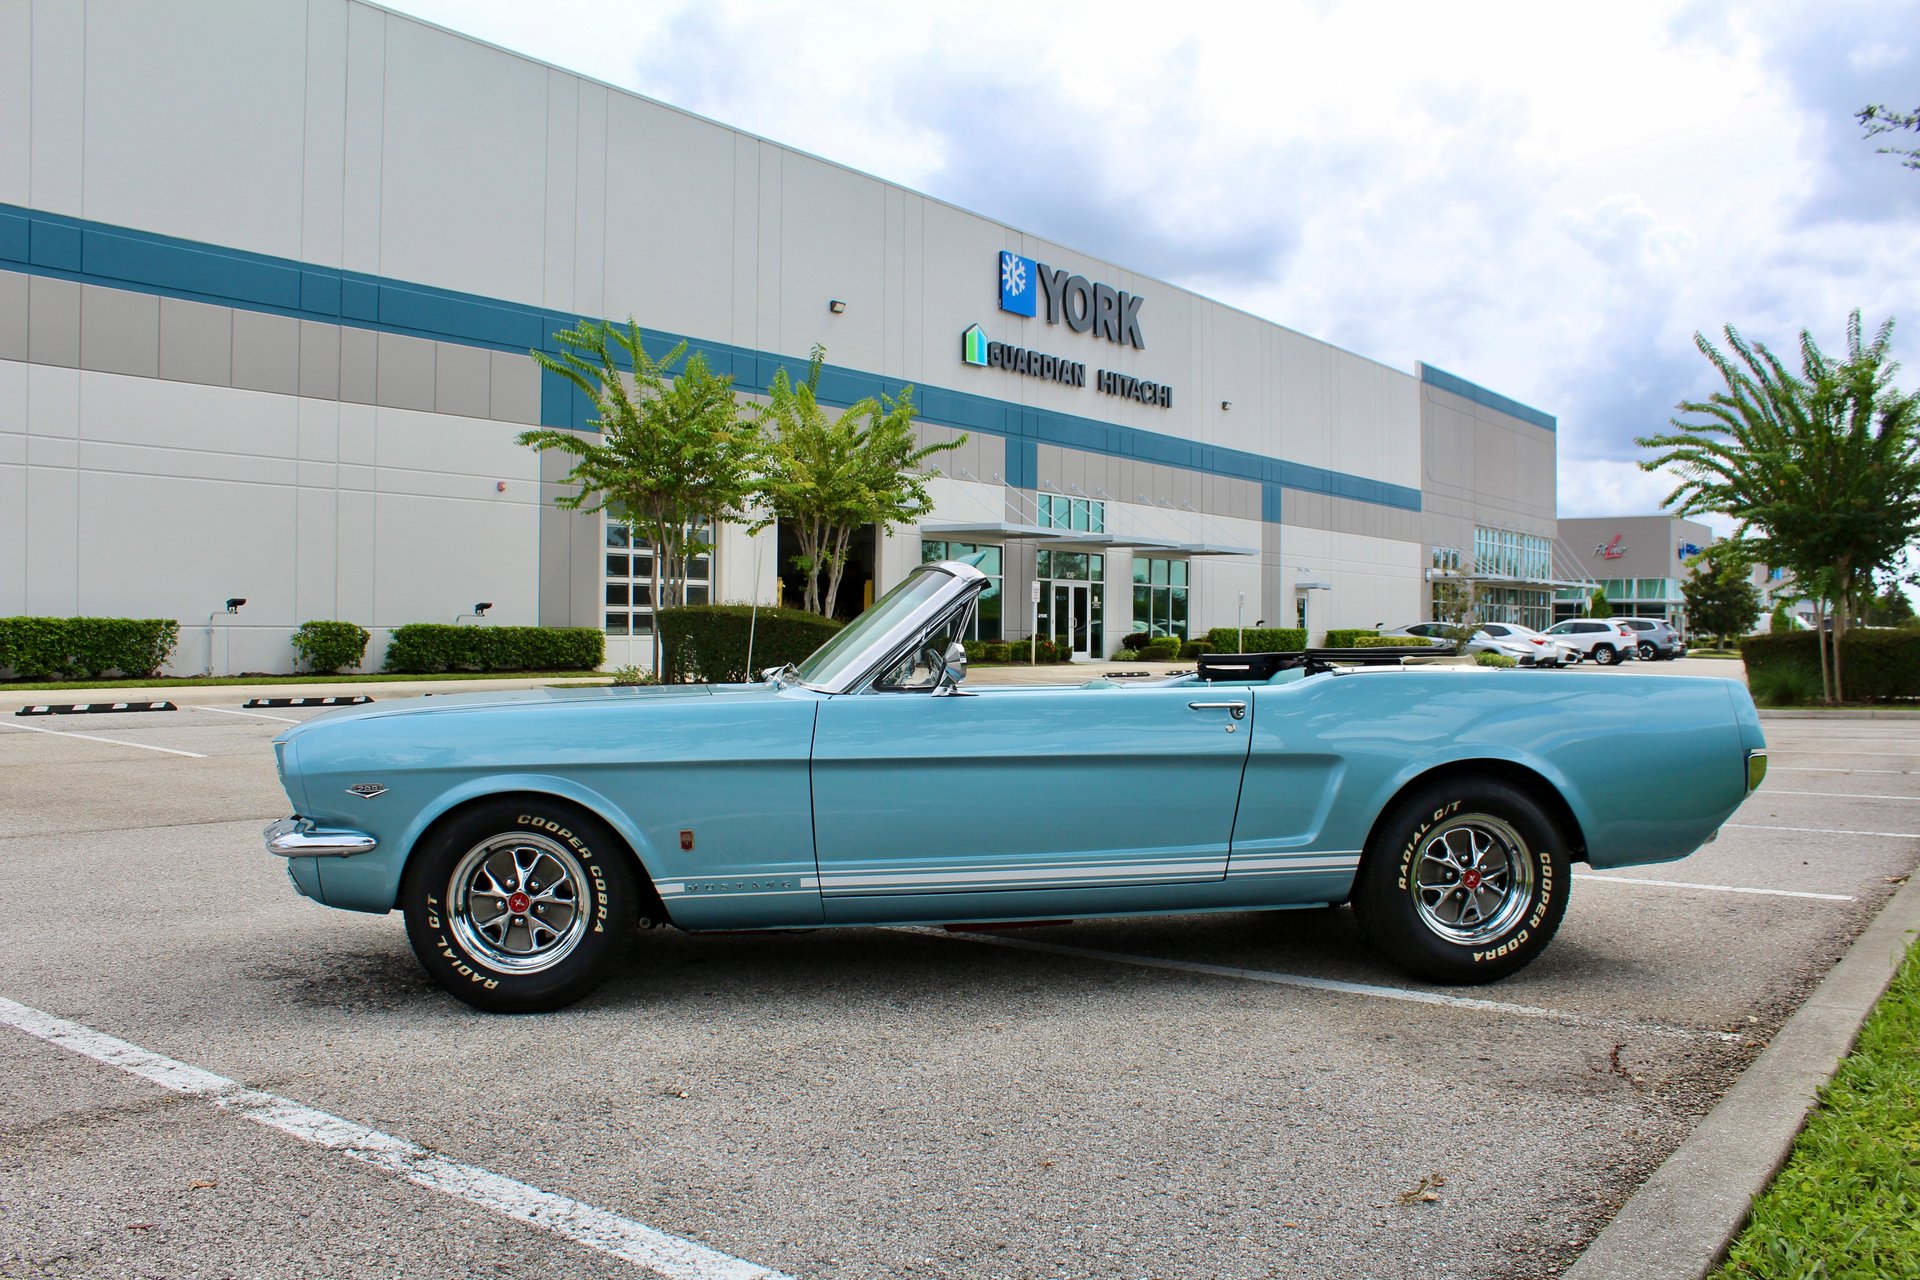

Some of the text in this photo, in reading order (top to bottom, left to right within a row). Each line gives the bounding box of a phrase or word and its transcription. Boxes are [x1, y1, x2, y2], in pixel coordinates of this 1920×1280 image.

[1037, 262, 1145, 350] YORK
[988, 341, 1086, 387] GUARDIAN
[1098, 369, 1173, 409] HITACHI
[517, 814, 608, 933] COOPER COBRA
[688, 880, 791, 893] MUSTANG
[1398, 800, 1462, 890] RADIAL G/T
[426, 894, 500, 991] RADIAL G/T
[1472, 852, 1552, 962] COOPER COBRA
